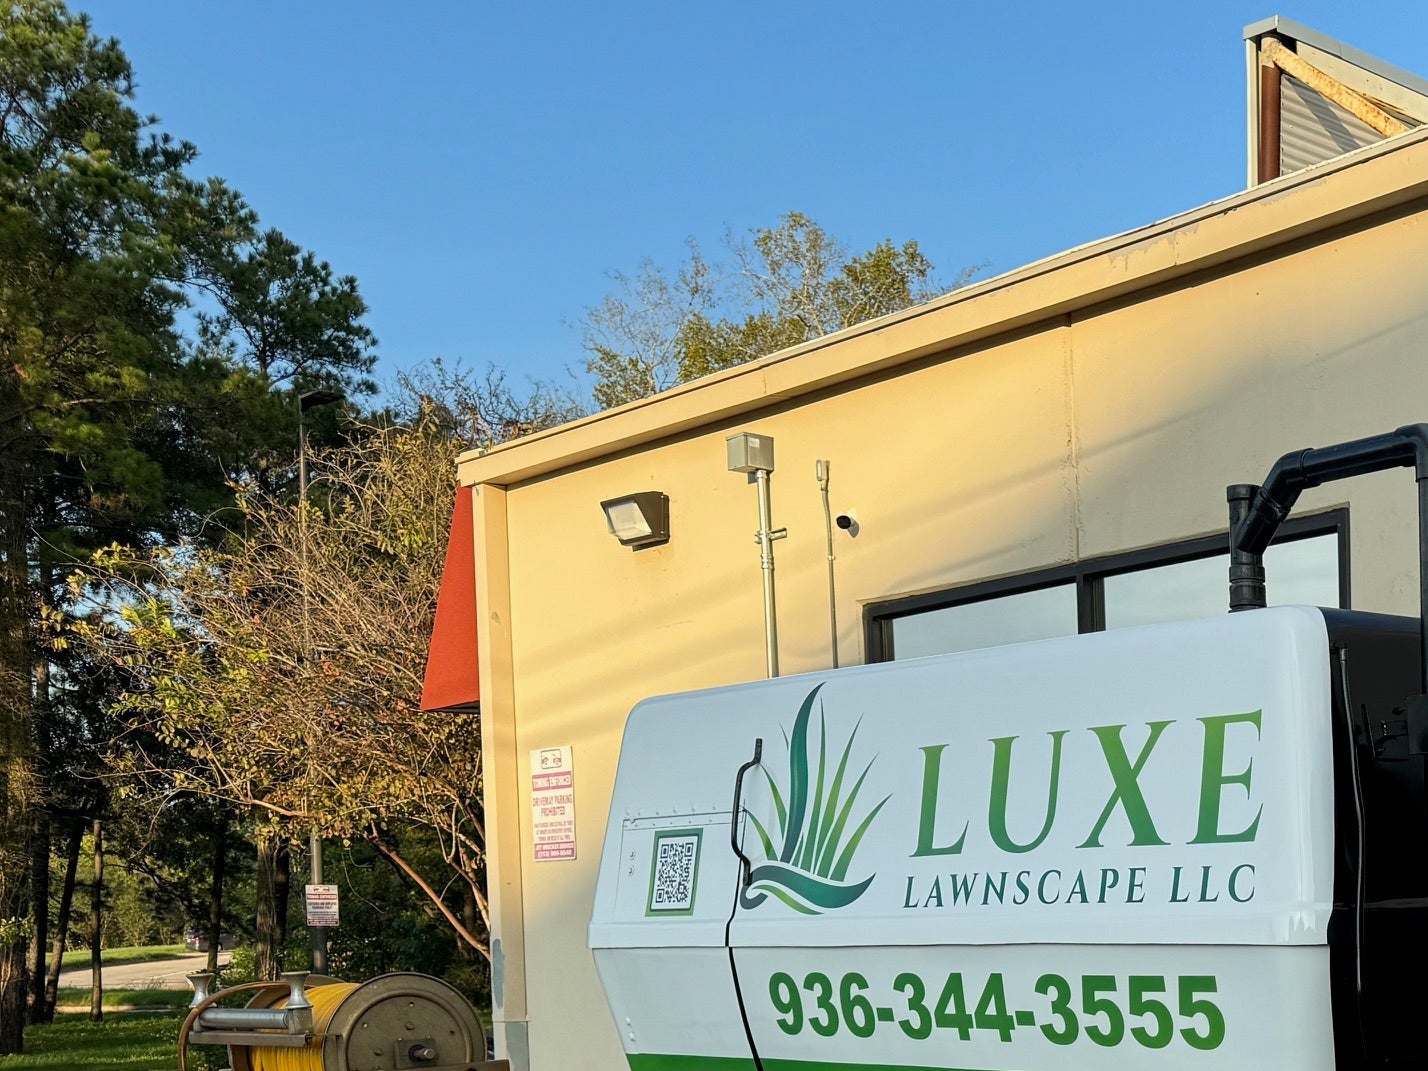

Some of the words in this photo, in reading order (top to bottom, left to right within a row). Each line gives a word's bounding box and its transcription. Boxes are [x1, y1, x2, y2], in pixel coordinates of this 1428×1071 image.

[909, 709, 1264, 858] LUXE
[902, 866, 1147, 909] LAWNSCAPE
[1168, 863, 1257, 903] LLC
[768, 971, 1226, 1052] 936-344-3555
